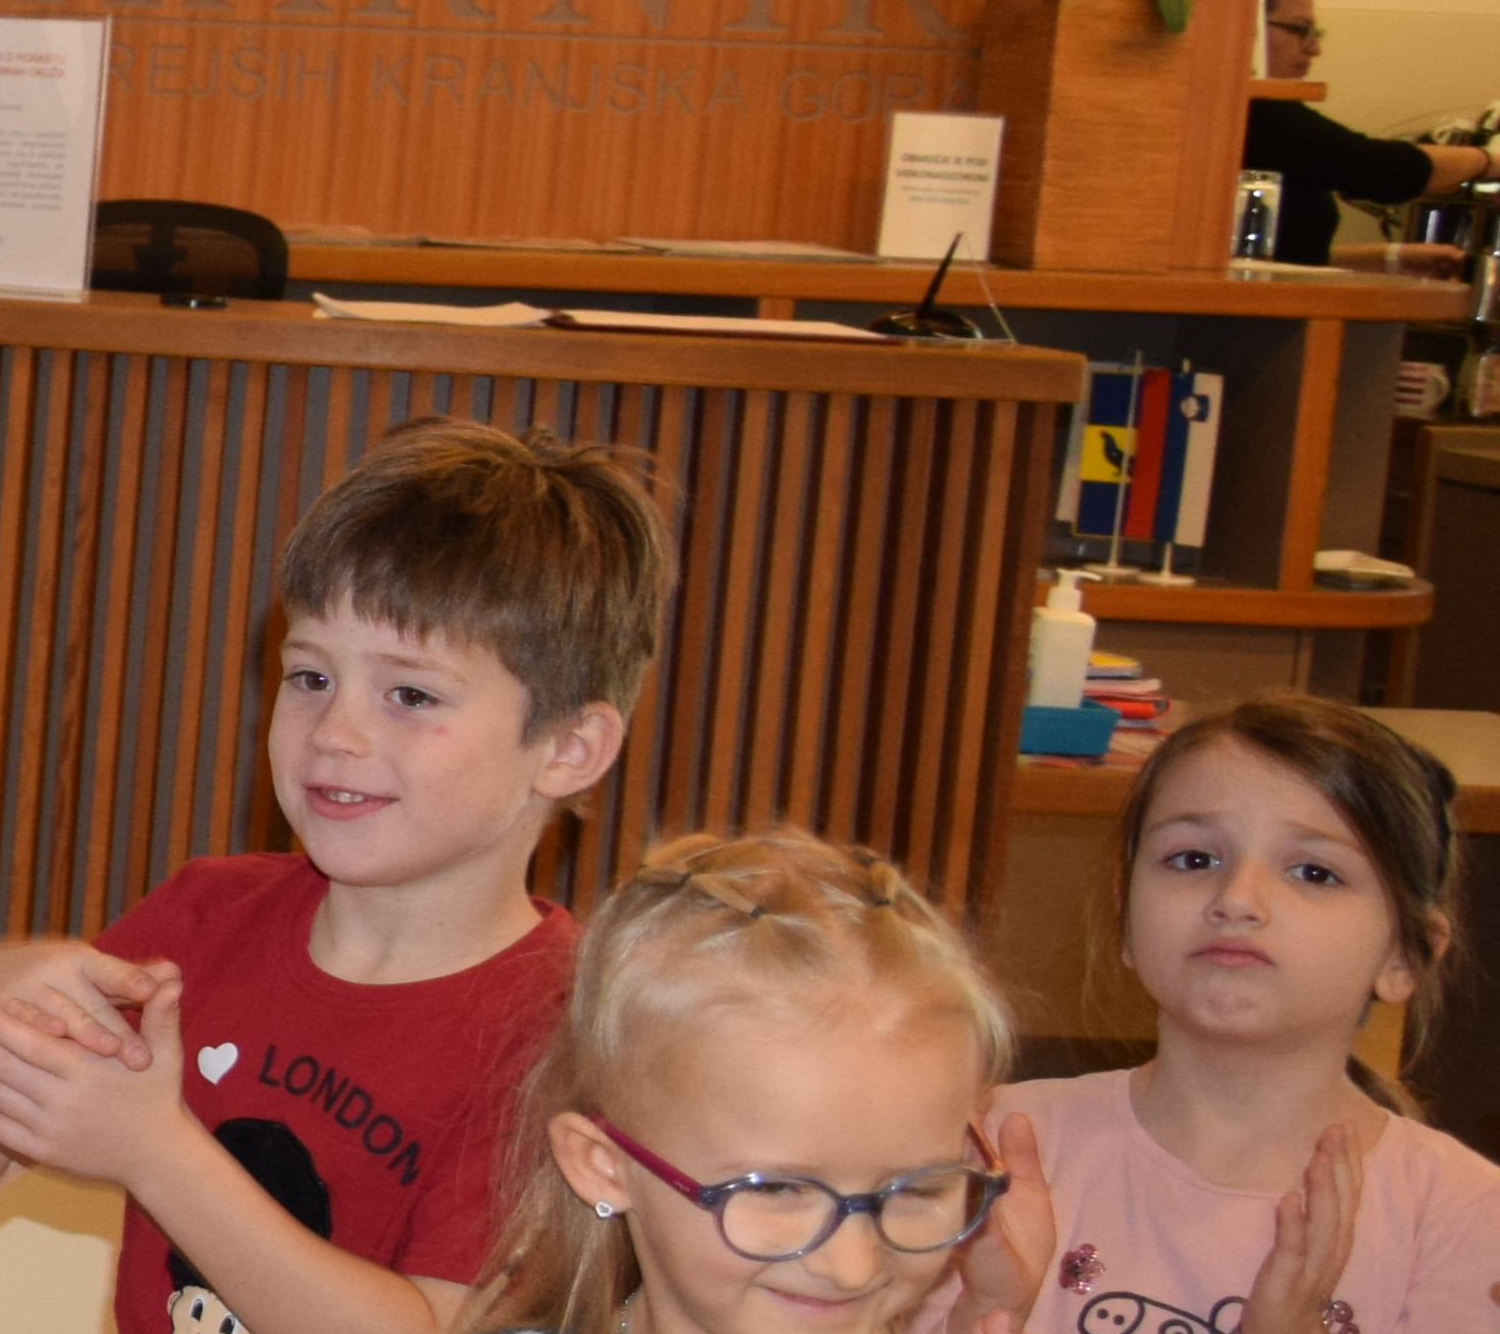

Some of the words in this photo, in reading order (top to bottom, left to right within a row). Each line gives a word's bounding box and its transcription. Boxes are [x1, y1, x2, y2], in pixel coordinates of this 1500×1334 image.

[108, 34, 340, 105] REJŠIH
[368, 53, 749, 116] KRANJSKA
[258, 1043, 420, 1187] LONDON
